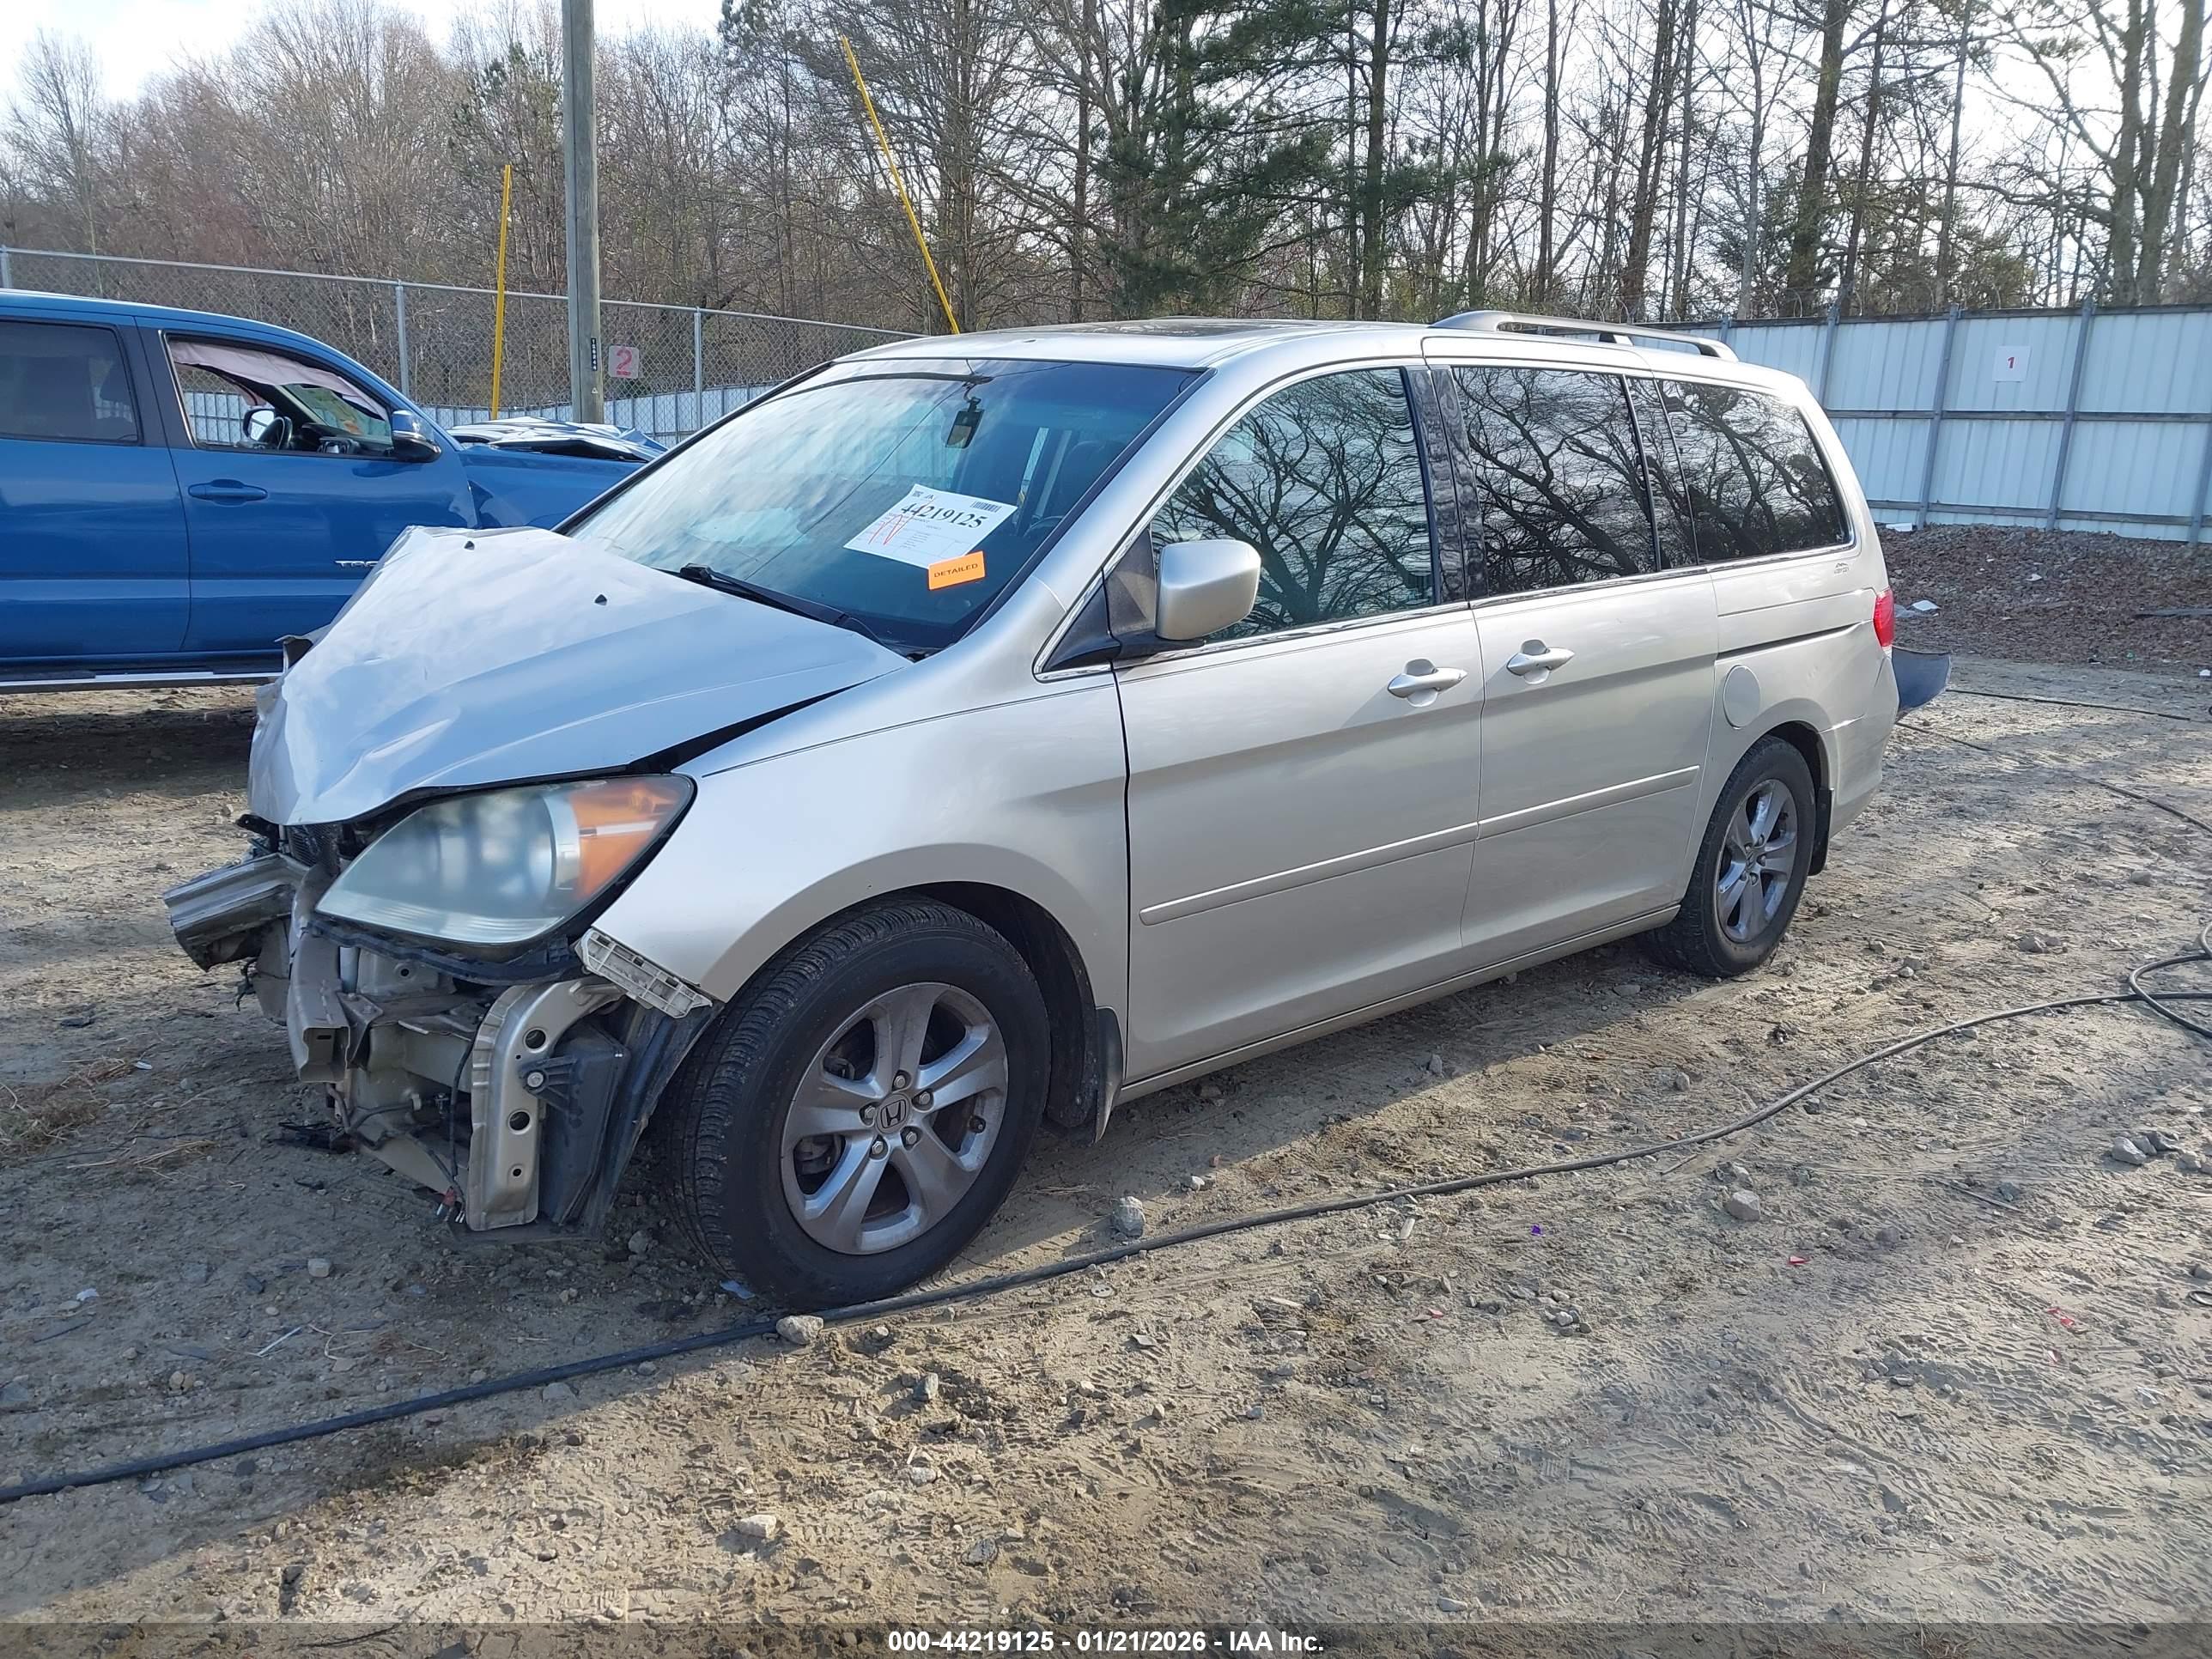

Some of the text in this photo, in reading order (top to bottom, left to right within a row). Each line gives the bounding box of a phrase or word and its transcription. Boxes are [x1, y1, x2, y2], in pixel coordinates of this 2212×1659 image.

[616, 349, 633, 376] 2
[2007, 356, 2015, 369] 1
[901, 502, 988, 529] 44219125
[933, 563, 978, 578] DETAILED
